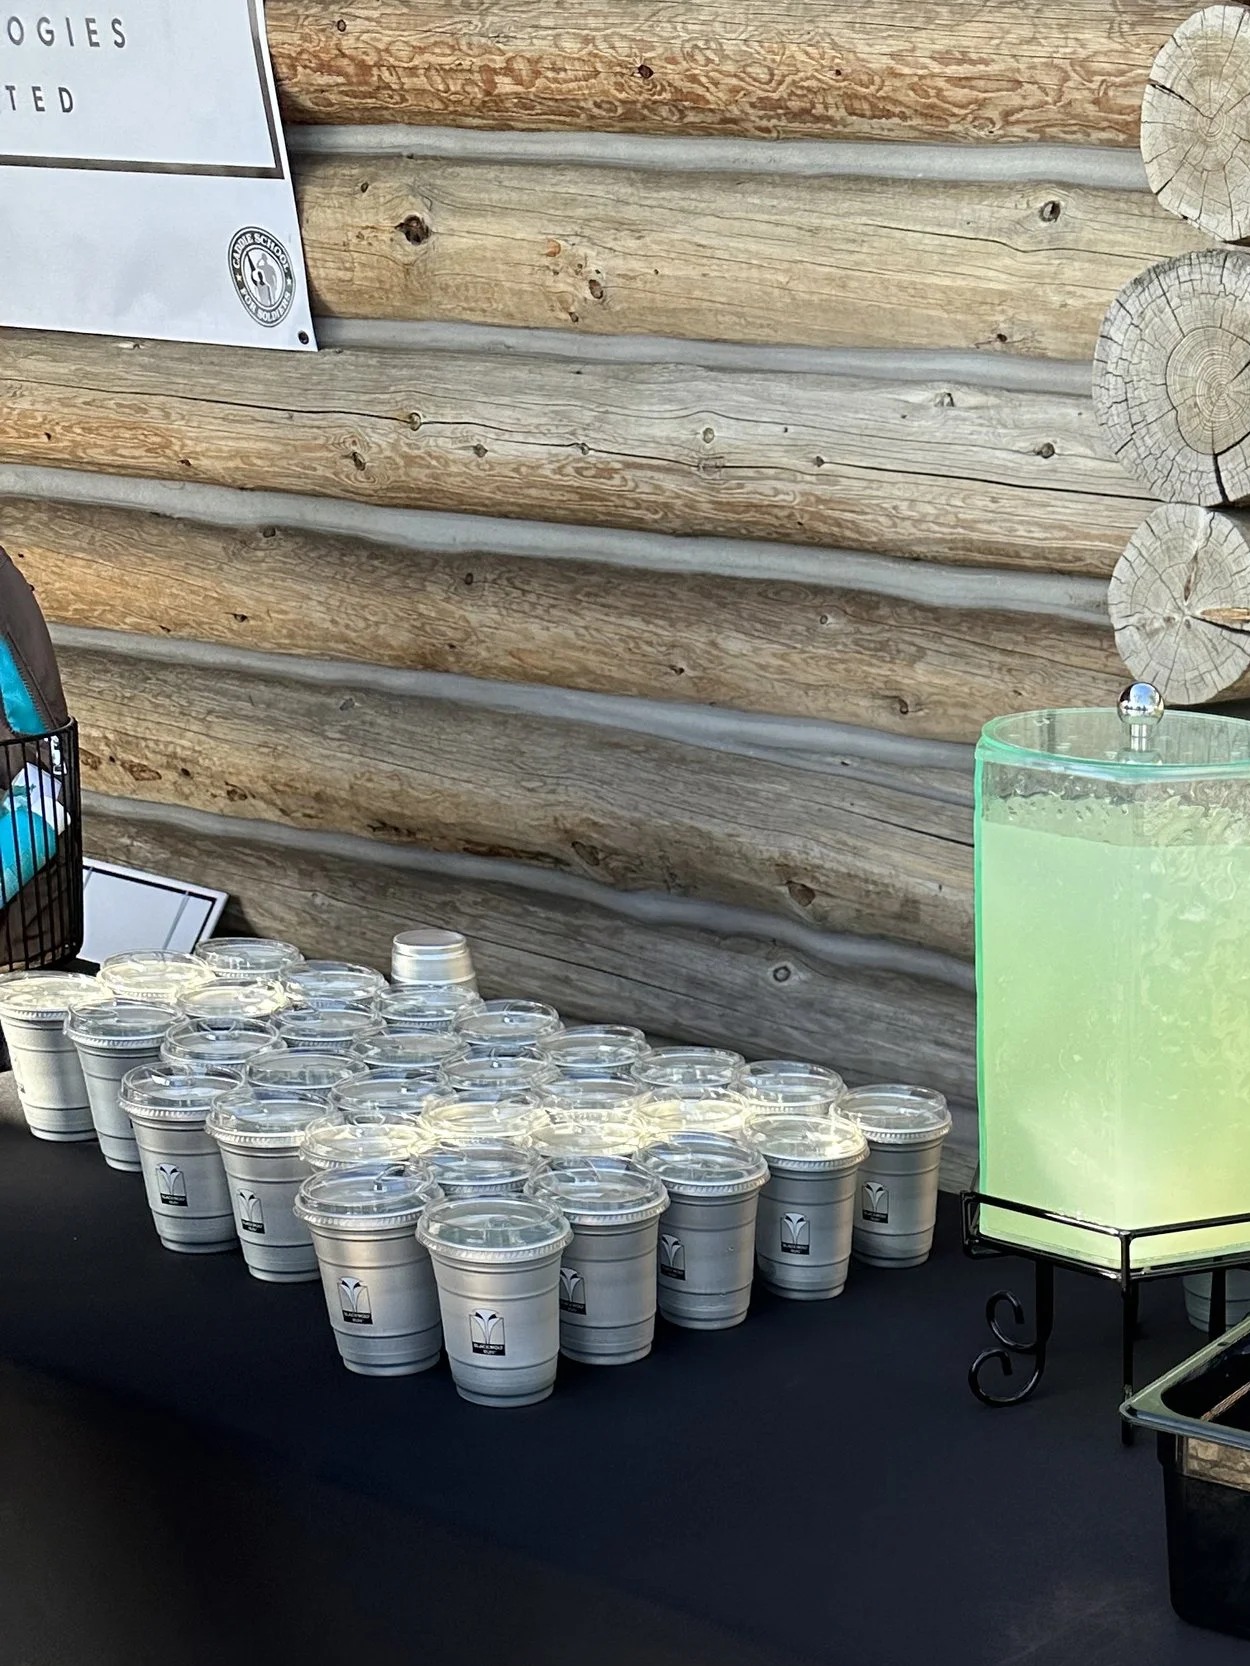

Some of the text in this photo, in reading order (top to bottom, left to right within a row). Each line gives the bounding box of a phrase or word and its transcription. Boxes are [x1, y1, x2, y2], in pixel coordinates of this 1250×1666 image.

[7, 16, 126, 48] OGIES
[232, 233, 290, 272] CADDIE SCHOOL
[240, 287, 259, 315] FOR
